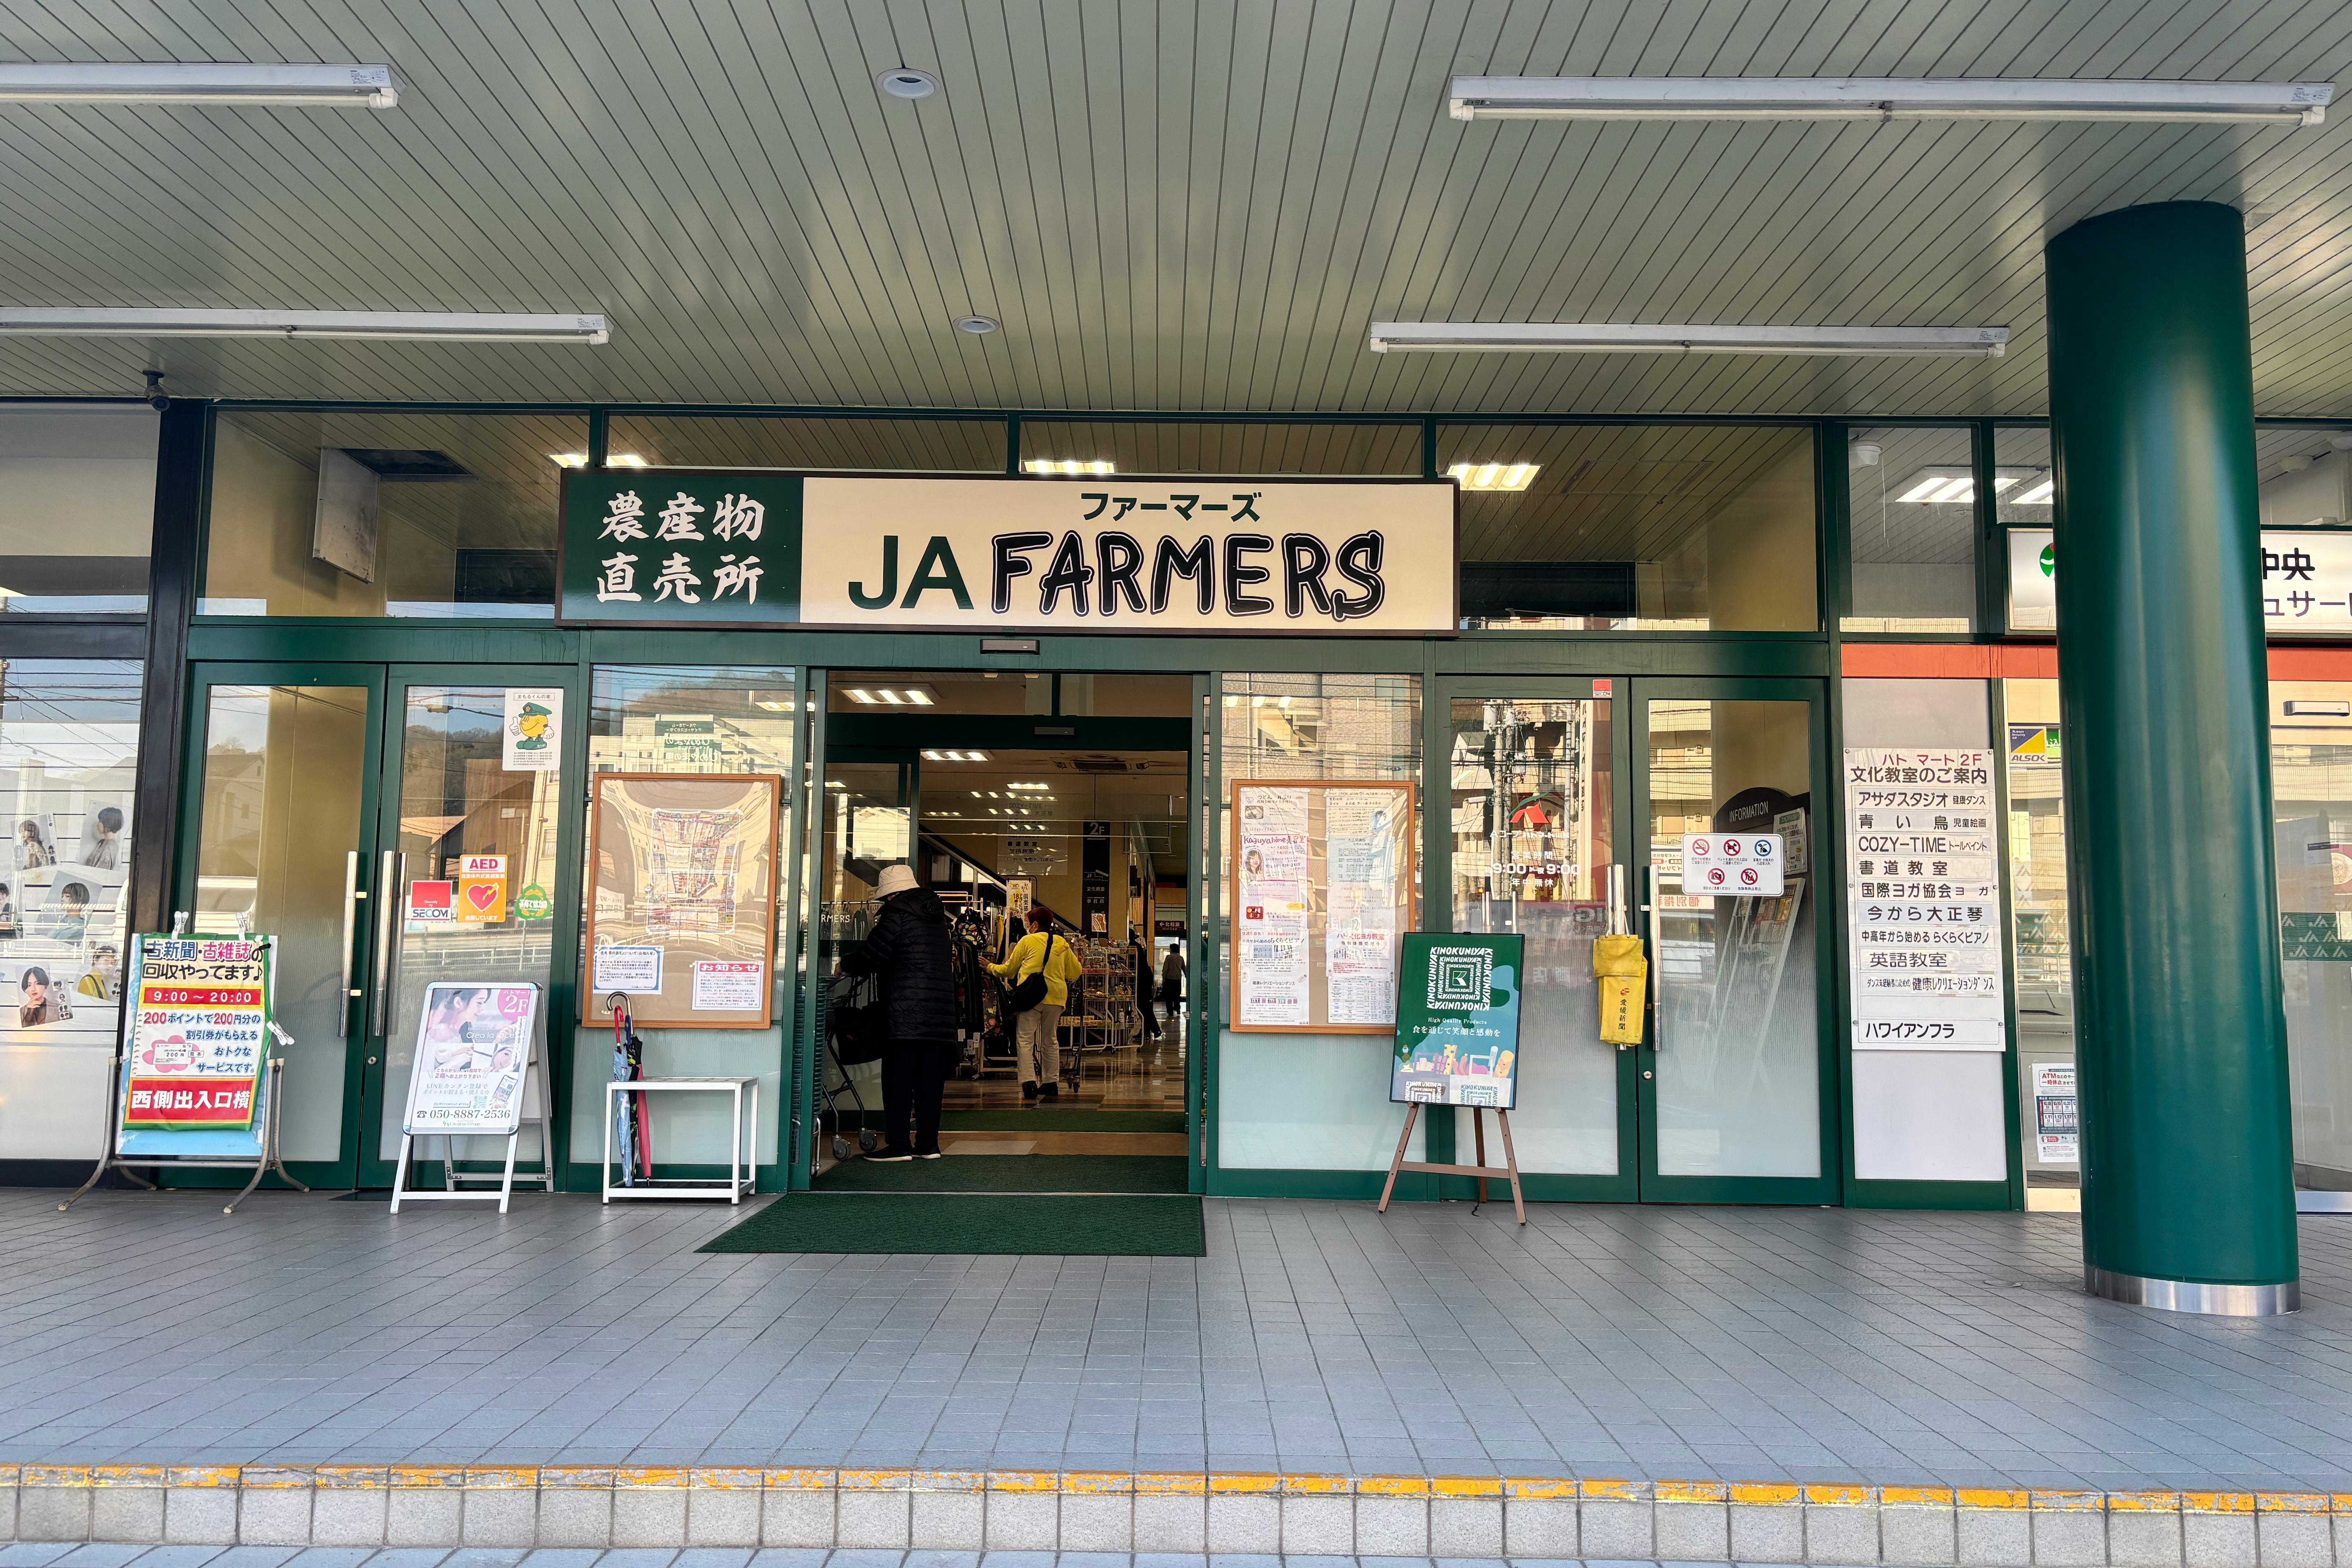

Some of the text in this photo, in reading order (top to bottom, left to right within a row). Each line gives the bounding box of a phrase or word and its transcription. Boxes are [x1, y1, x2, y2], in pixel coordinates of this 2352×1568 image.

[1080, 493, 1262, 524] ファーマーズ
[602, 492, 768, 543] 農産物
[2262, 546, 2316, 581] 中央
[595, 553, 763, 605] 直売所
[848, 529, 1387, 620] JA FARMERS
[2264, 590, 2352, 618] ュサー
[1850, 766, 1987, 784] 文化教室のご案内
[1858, 792, 1986, 807] アサダスタジオ 健康ダンス
[1729, 801, 1769, 823] INFORMATION
[1090, 822, 1105, 835] 2F
[1858, 814, 1987, 830] 青い鳥 児童絵画
[1858, 836, 1987, 853] COZY-TIME トールペイント
[469, 859, 498, 870] AED
[1858, 860, 1948, 876] 書道教室
[1511, 878, 1554, 887] 年中無休
[1862, 882, 1951, 898] 国際ヨガ協会
[413, 909, 448, 918] SECOM
[1867, 905, 1983, 922] 今から大正琴
[1862, 930, 1989, 944] 中高年から始める らくらくピアノ
[144, 940, 263, 963] 古新聞・古雑誌の
[1430, 946, 1486, 956] KINOKUNIYA
[700, 964, 758, 972] お知らせ
[1869, 952, 1948, 968] 英語教室
[1426, 954, 1438, 1009] KINOKUNIYA
[1482, 947, 1493, 1003] KINOKUNIYA
[1912, 977, 1994, 991] 健康レクリエーションダンス
[153, 992, 188, 1002] 9:00
[210, 992, 252, 1003] 20:00
[503, 995, 528, 1013] 2F
[1434, 1000, 1490, 1011] KINOKUNIYA
[143, 1012, 262, 1026] 200ポイントで200円分の
[1618, 998, 1627, 1030] 愛媛新聞
[185, 1029, 259, 1042] 割引券がもらえる
[1412, 1025, 1501, 1037] 食を通じて笑顔と感動を
[1866, 1022, 1955, 1039] ハワイアンフラ
[214, 1046, 252, 1057] おトクな
[196, 1062, 255, 1074] サービスです。
[131, 1090, 251, 1111] 西側出入口横
[429, 1109, 511, 1119] 050-8887-2536
